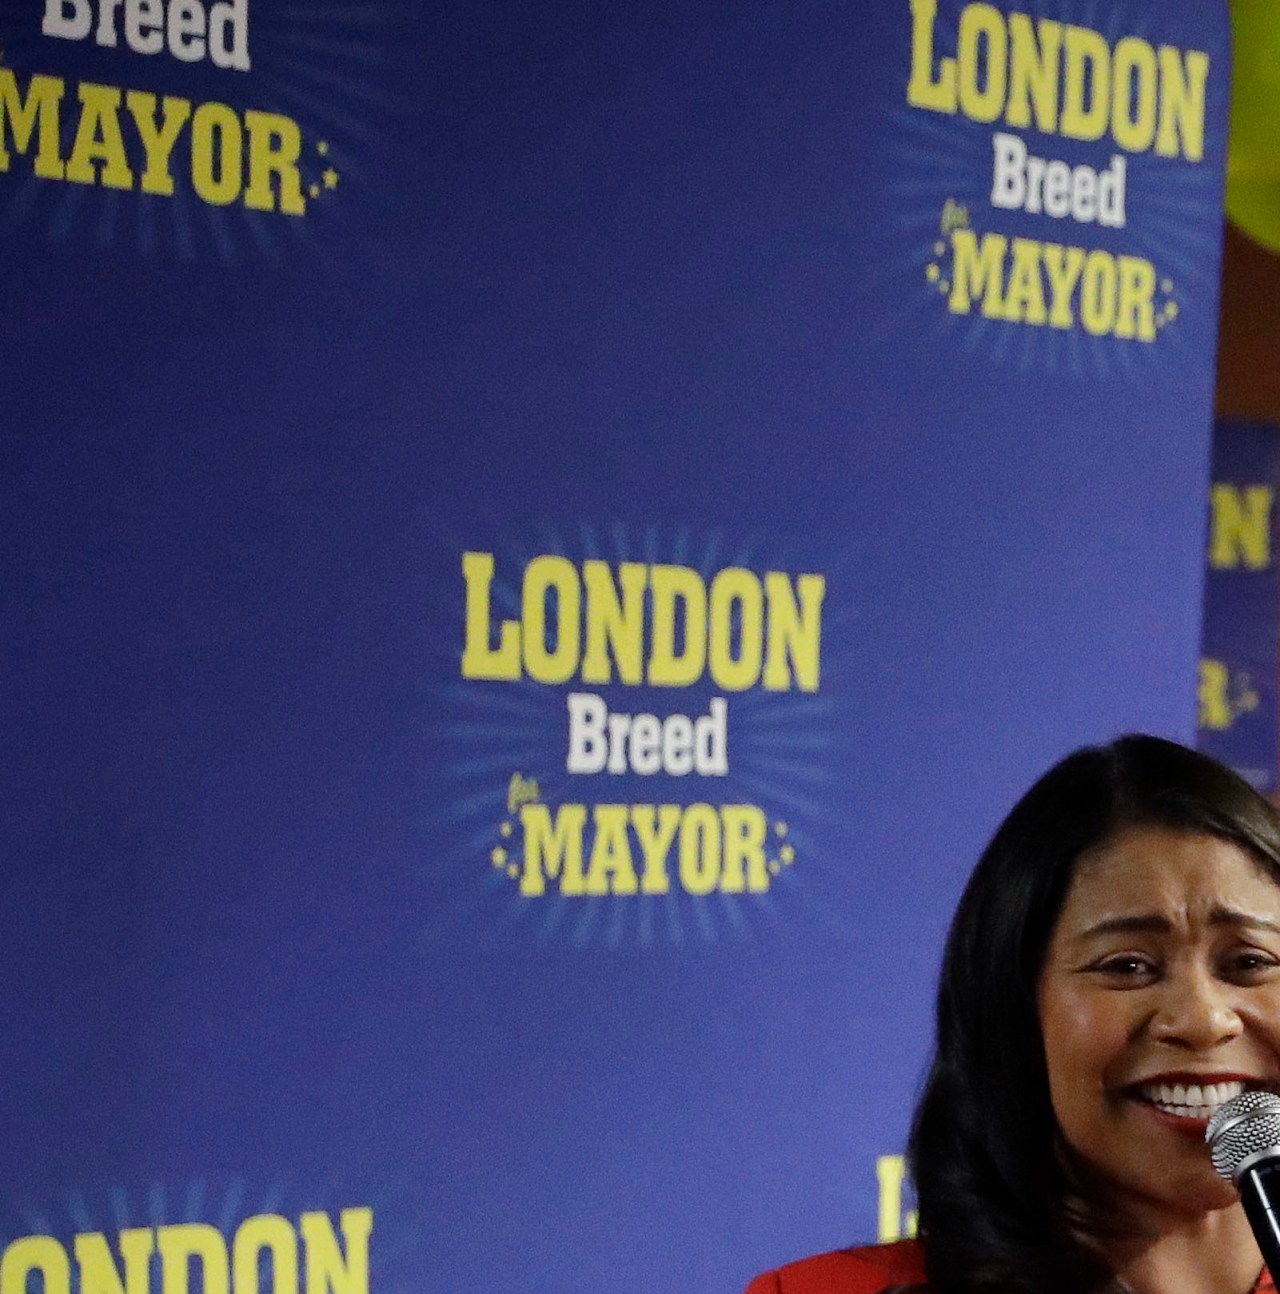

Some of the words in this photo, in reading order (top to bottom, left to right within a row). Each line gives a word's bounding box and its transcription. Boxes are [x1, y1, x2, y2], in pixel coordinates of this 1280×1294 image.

[907, 0, 1210, 162] LONDON
[0, 66, 305, 216] MAYOR
[990, 131, 1126, 228] Breed
[948, 228, 1157, 343] MAYOR
[460, 550, 826, 693] LONDON
[566, 692, 730, 777] Breed
[519, 802, 770, 897] MAYOR
